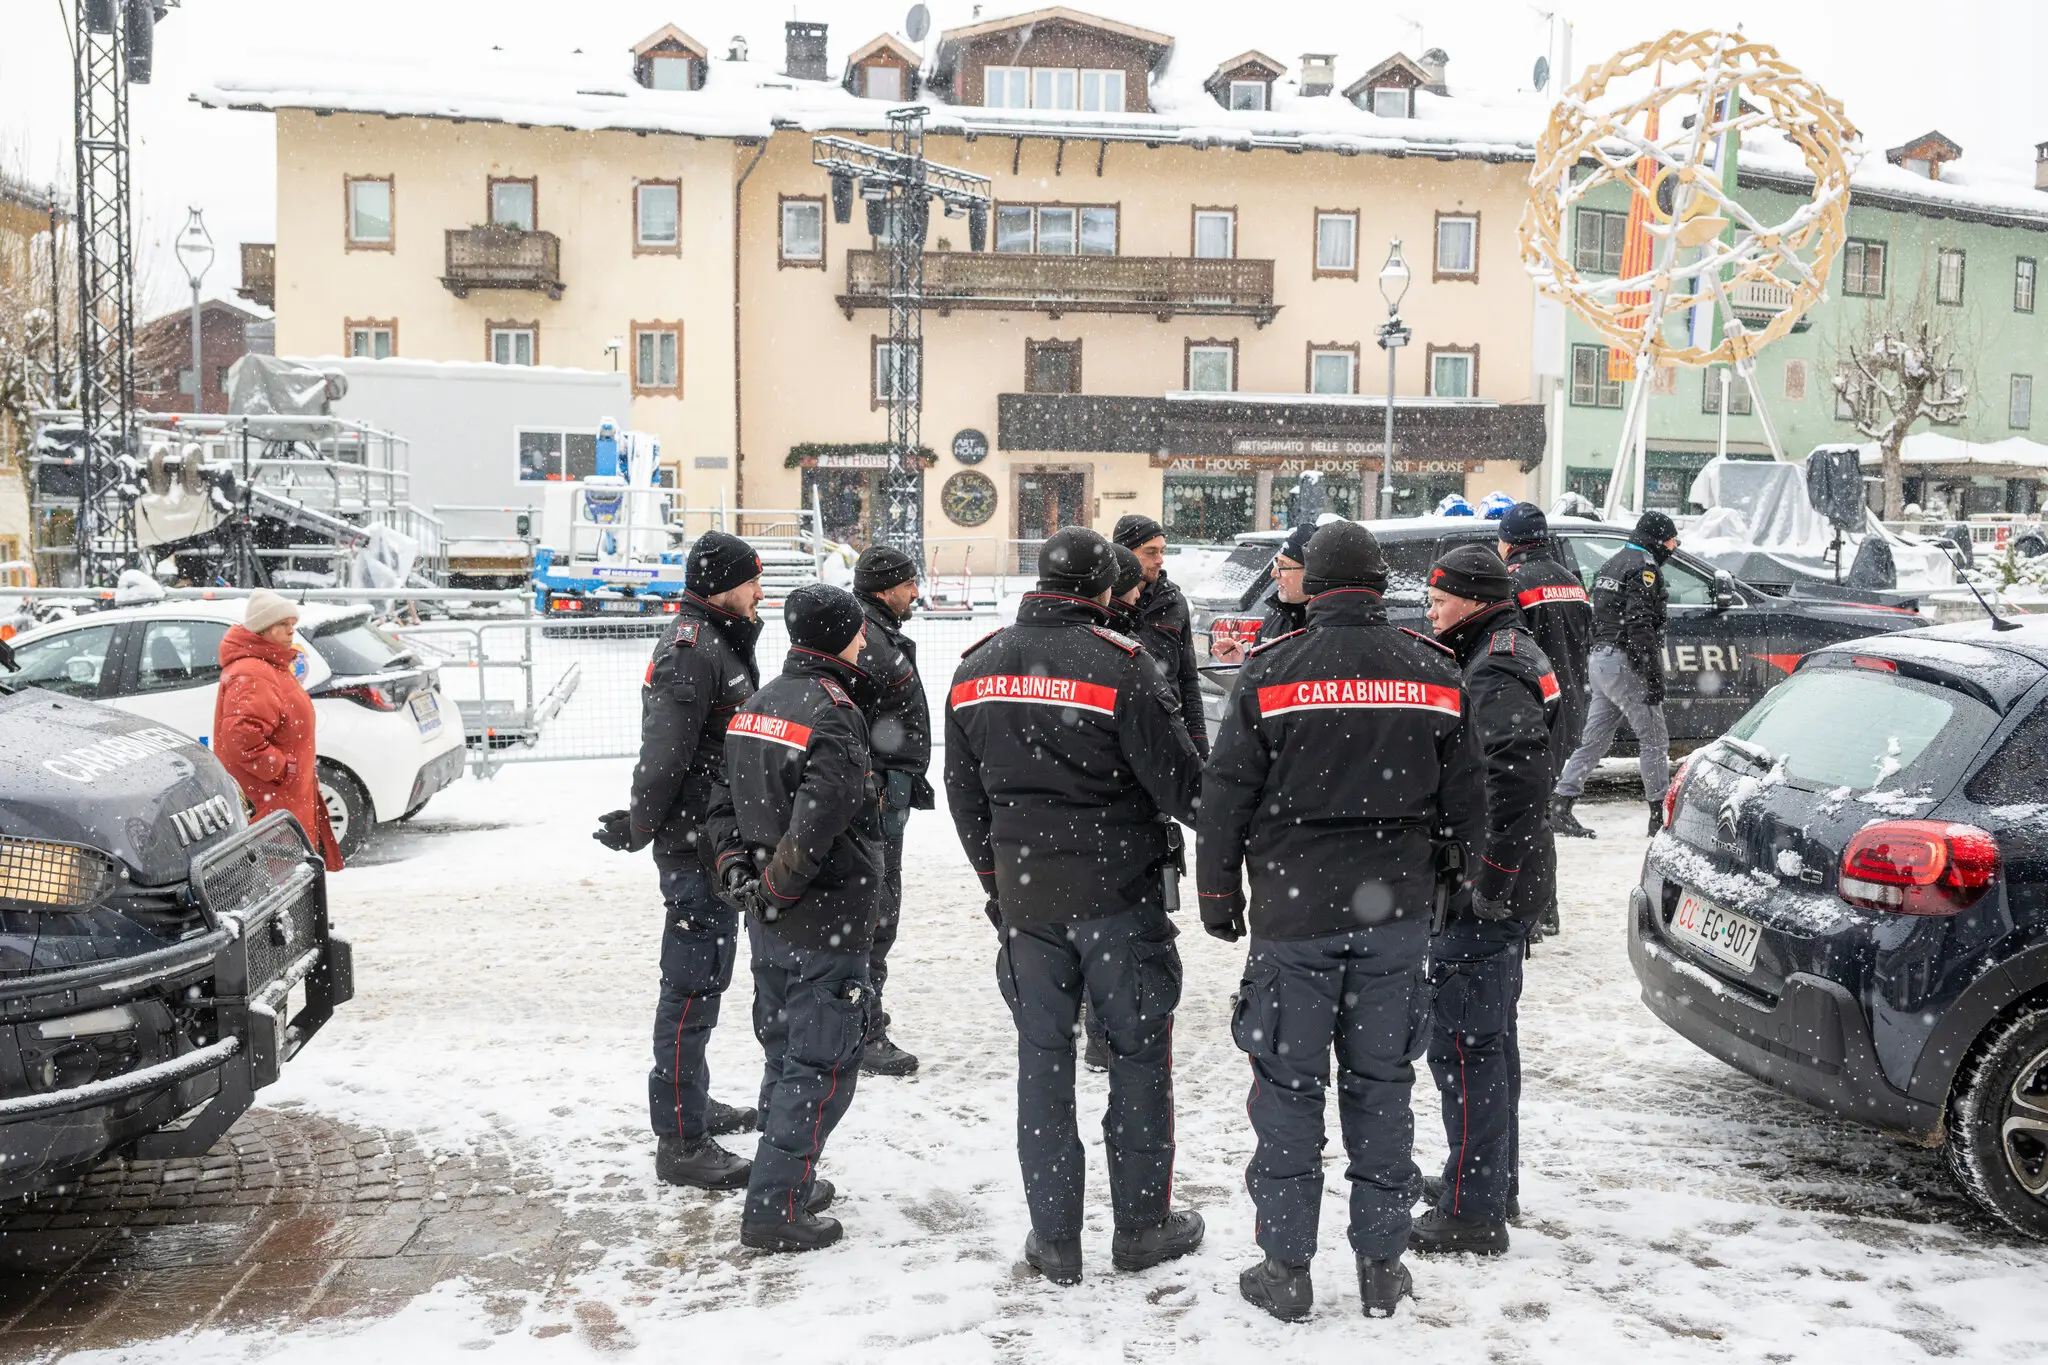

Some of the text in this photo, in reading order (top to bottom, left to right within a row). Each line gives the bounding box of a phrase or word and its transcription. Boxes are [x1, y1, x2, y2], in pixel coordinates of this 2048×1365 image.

[955, 438, 976, 447] ART
[1238, 440, 1396, 453] ARTIGIANATO NELLE DOLOMII
[954, 447, 986, 456] HOUSE
[826, 455, 890, 466] Art Hous
[1169, 458, 1251, 471] ART HOUSE
[1279, 459, 1360, 472] ART HOUSE
[1419, 460, 1464, 473] HOUSE
[976, 676, 1077, 701] CARABINIERI
[1297, 681, 1427, 703] CARABINIERI
[169, 794, 235, 848] IVECO
[1800, 867, 1824, 885] C3
[1679, 897, 1758, 957] CC EG 907
